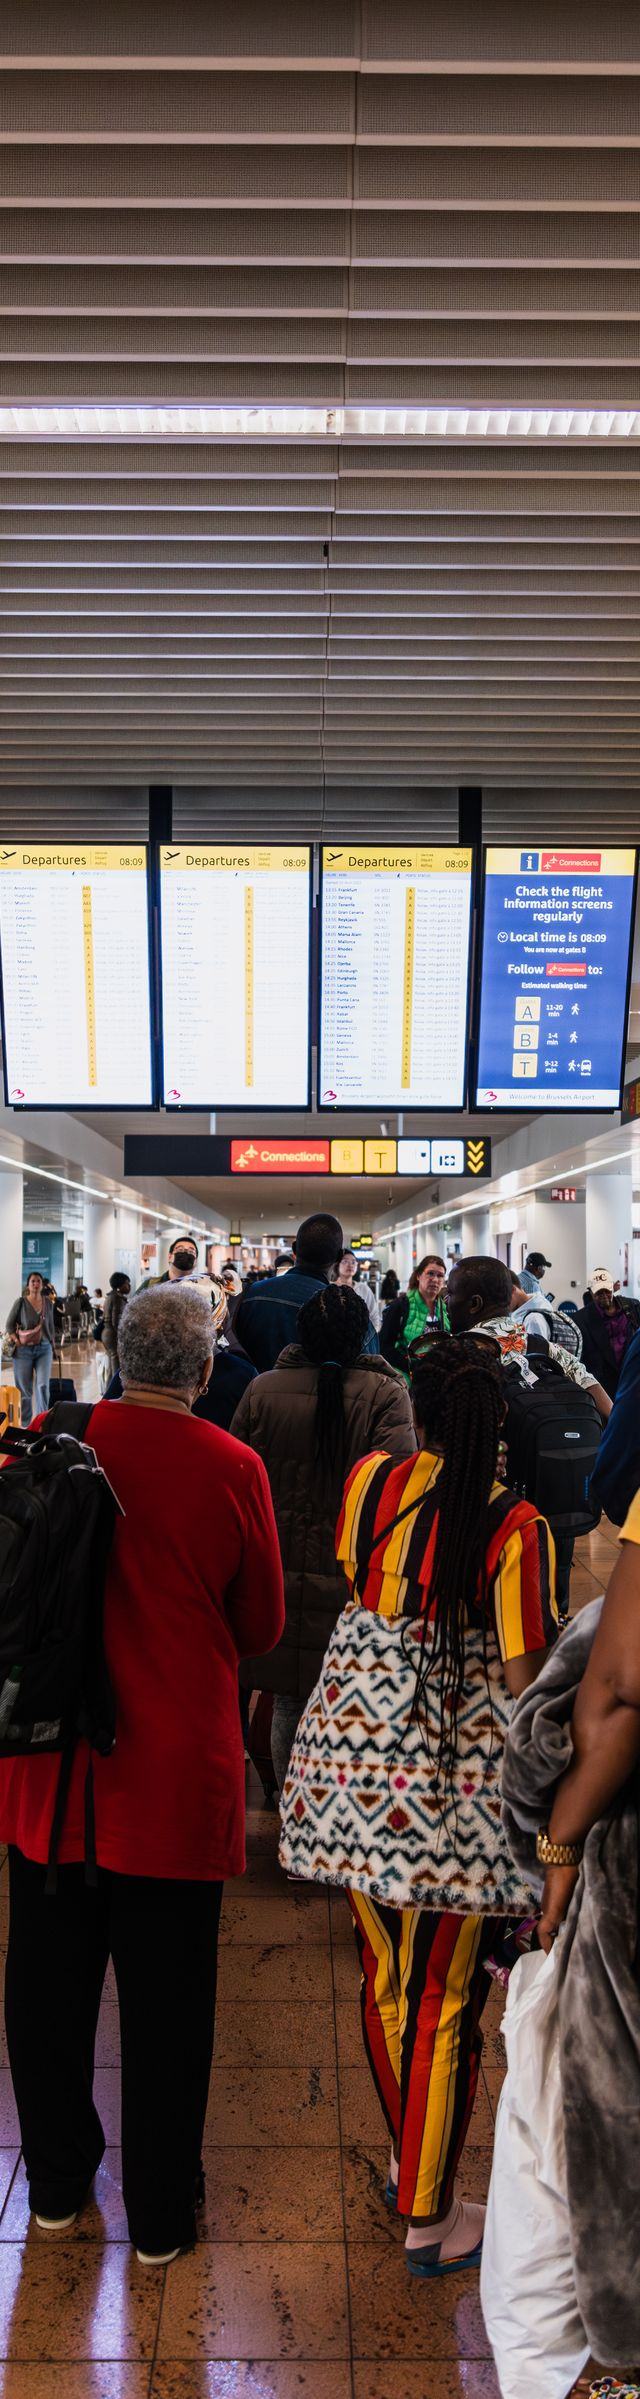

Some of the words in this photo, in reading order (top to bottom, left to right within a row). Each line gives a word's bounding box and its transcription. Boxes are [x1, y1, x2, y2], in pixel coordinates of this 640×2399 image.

[22, 854, 86, 866] Departures
[120, 858, 142, 866] 08:09
[186, 856, 250, 867] Departures
[283, 859, 306, 867] 08:09
[348, 856, 412, 868] Departures
[445, 860, 468, 868] 08:09
[559, 859, 599, 867] Connections
[516, 886, 548, 897] Check
[551, 886, 569, 897] the
[572, 886, 603, 898] flight
[504, 898, 569, 909] information
[572, 901, 613, 909] screens
[533, 911, 583, 923] regularly
[510, 932, 538, 942] Local
[541, 932, 565, 942] time
[569, 932, 577, 942] is
[581, 934, 606, 942] 08:09
[508, 964, 543, 974] Follow
[588, 965, 603, 974] to:
[551, 982, 573, 990] walking
[522, 1006, 533, 1018] A
[521, 1034, 531, 1047] B
[520, 1062, 530, 1075] T
[573, 1094, 595, 1102] Airport
[260, 1151, 325, 1163] Connections
[343, 1150, 351, 1160] B
[374, 1152, 387, 1169] T
